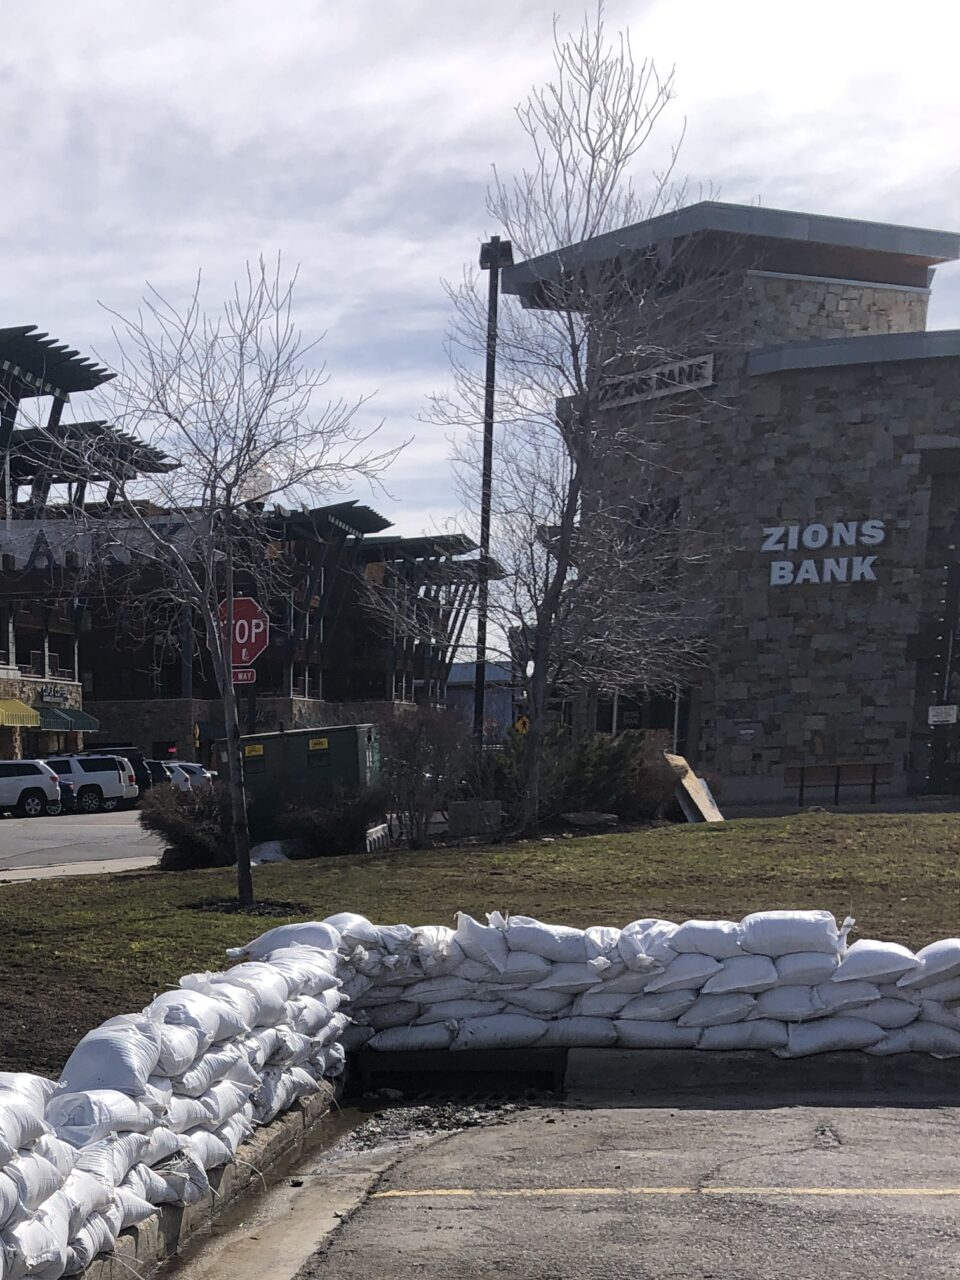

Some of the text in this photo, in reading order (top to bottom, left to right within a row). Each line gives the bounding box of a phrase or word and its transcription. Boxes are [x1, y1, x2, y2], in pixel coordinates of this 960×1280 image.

[759, 519, 886, 553] ZIONS
[768, 555, 878, 587] BANK
[220, 618, 265, 644] OP
[237, 671, 253, 681] WAY
